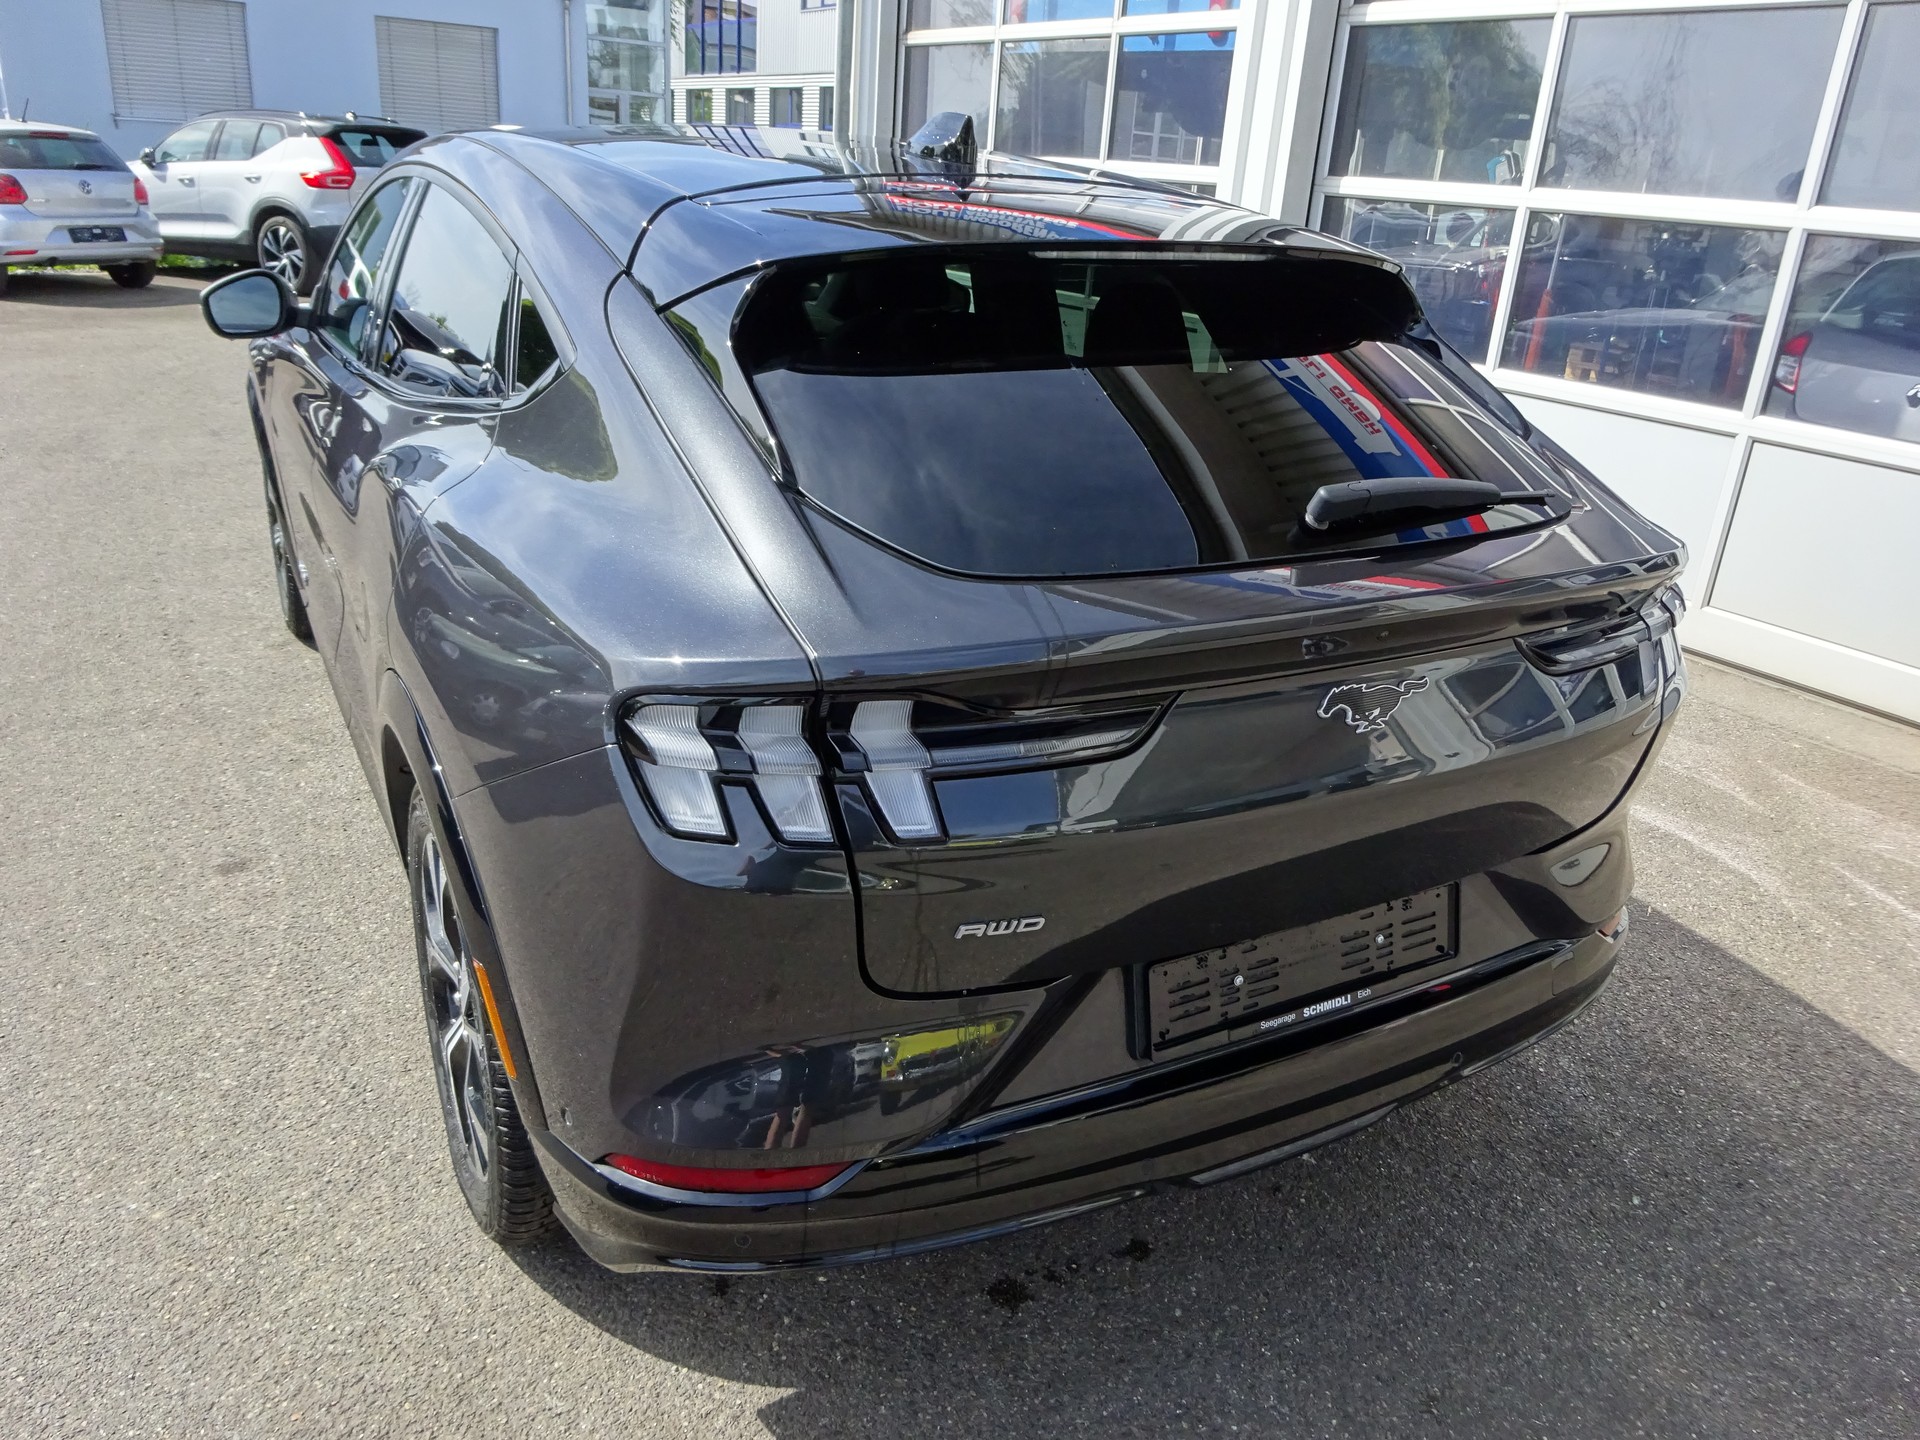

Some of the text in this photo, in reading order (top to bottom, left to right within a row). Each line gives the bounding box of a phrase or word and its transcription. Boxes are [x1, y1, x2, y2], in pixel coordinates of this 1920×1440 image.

[953, 915, 1046, 939] AWD
[1260, 988, 1372, 1029] Seegarage SCHMIDLI Eich
